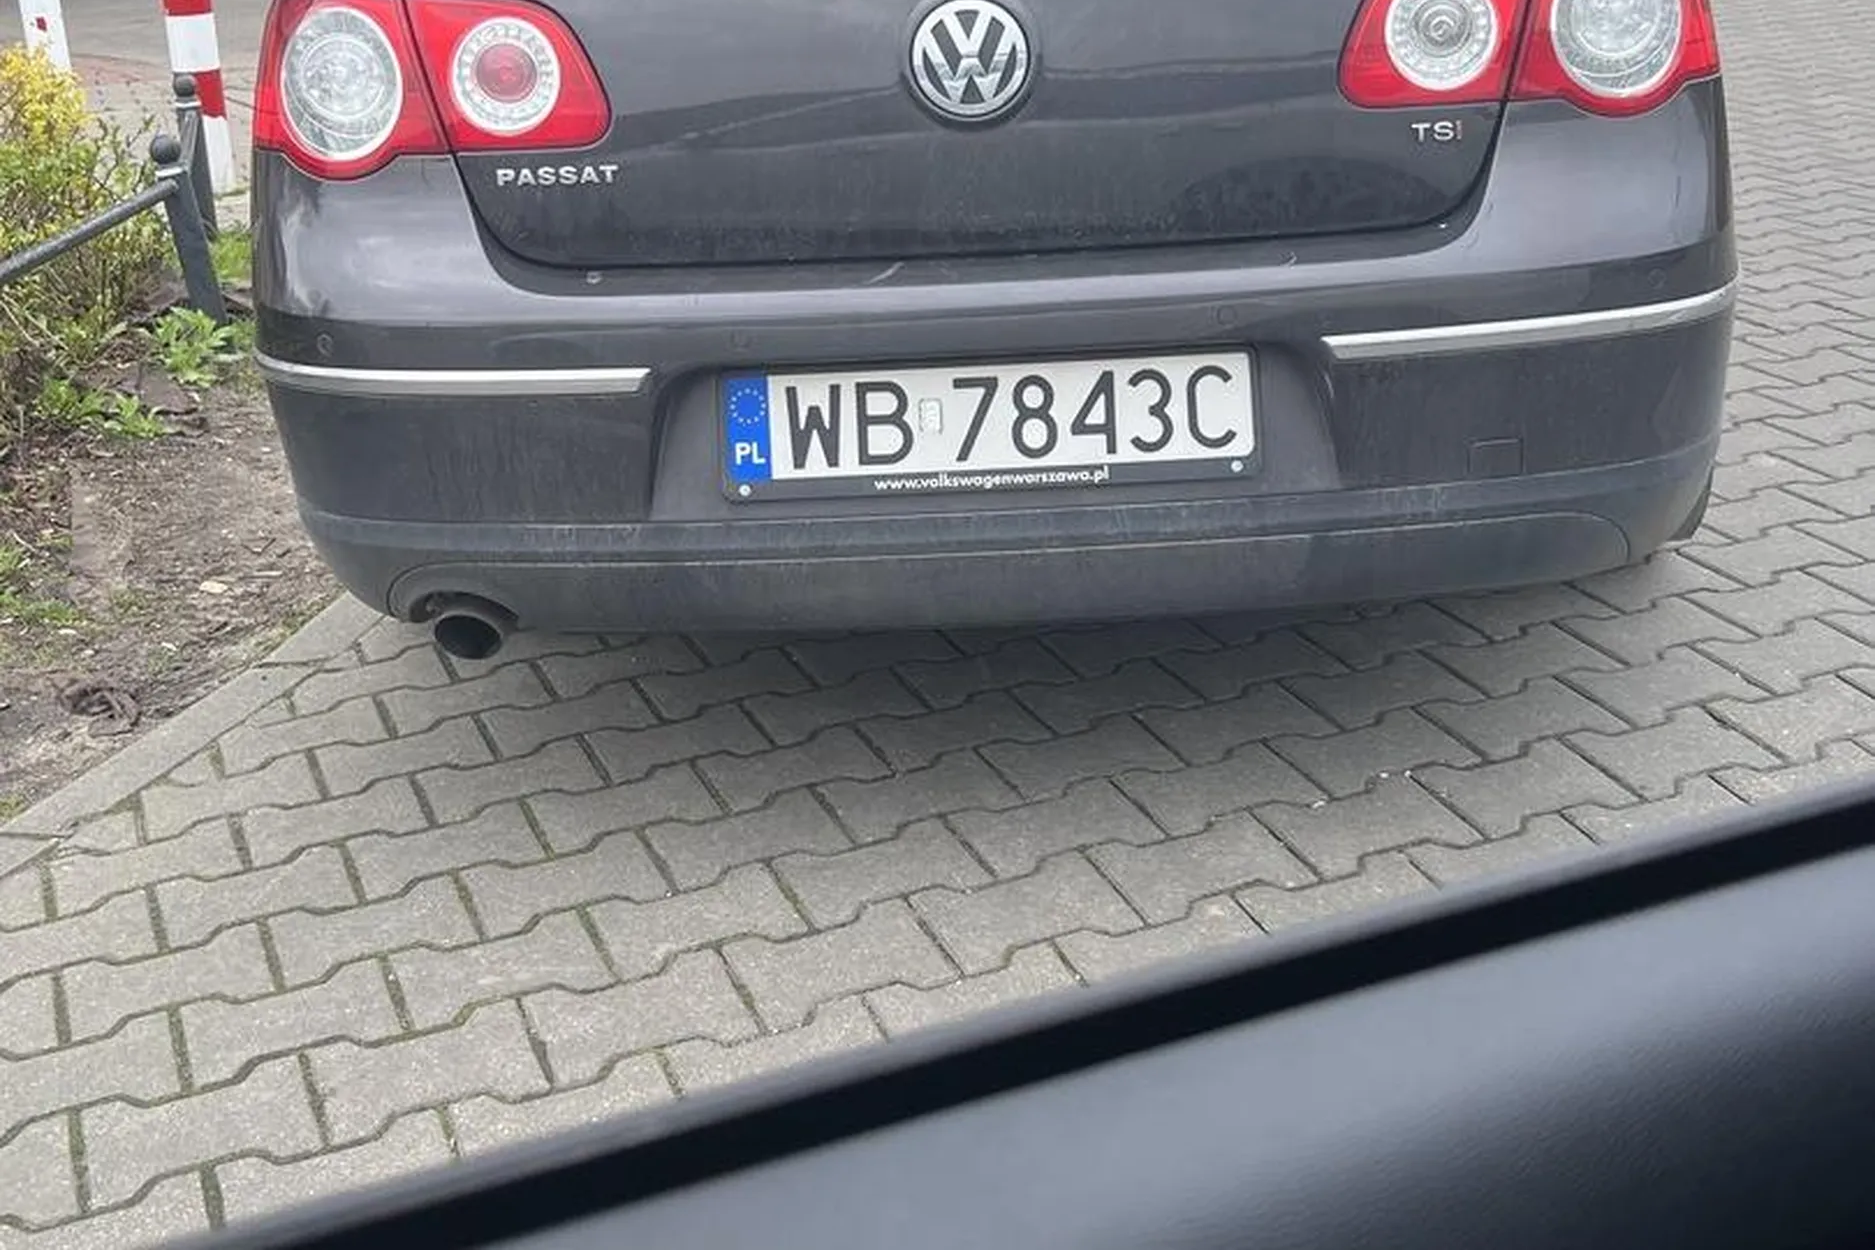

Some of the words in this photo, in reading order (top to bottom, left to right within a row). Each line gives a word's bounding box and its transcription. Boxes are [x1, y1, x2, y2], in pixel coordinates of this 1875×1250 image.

[1411, 120, 1462, 142] TSI
[496, 165, 619, 186] PASSAT
[785, 380, 914, 470] WB
[952, 364, 1238, 462] 7843C
[735, 442, 766, 465] PL
[874, 465, 1110, 491] www.volkswagenwarszawa.pl
